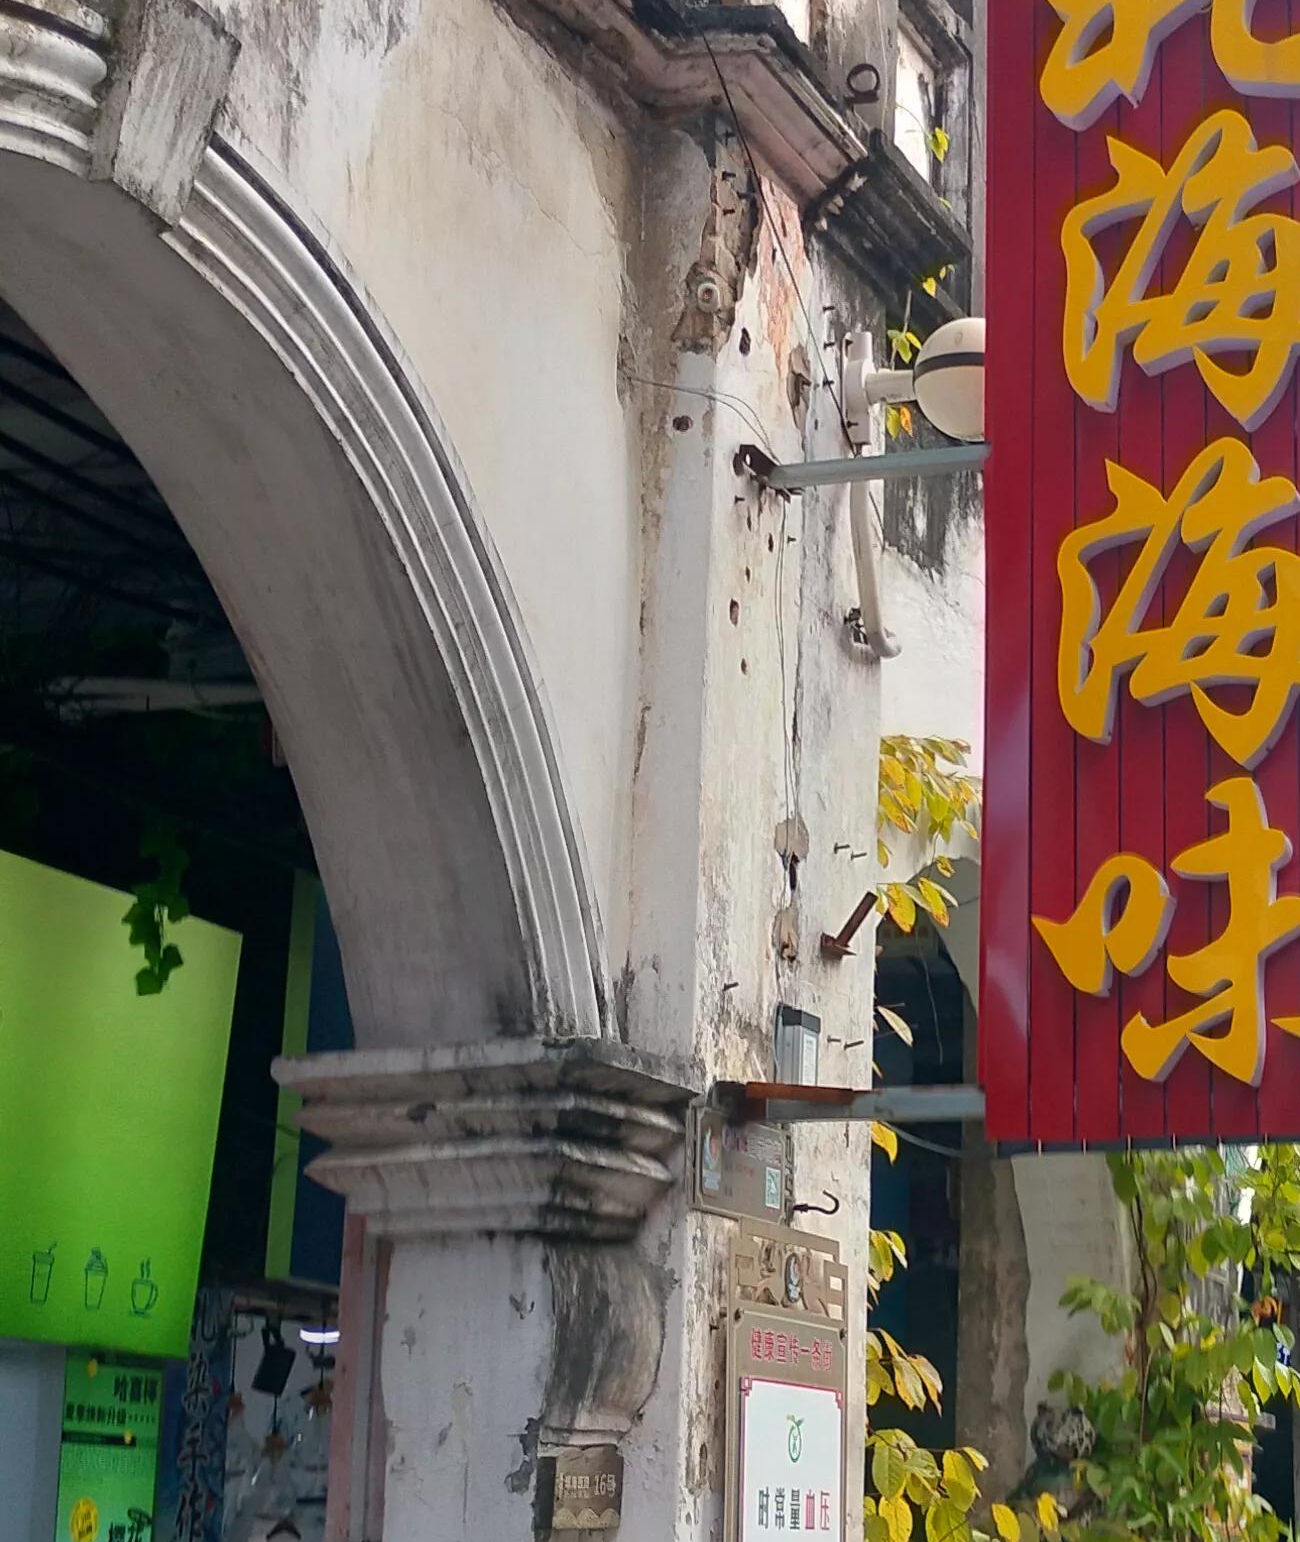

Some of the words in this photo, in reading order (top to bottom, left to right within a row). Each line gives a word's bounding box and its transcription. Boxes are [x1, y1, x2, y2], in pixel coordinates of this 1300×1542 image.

[758, 1487, 831, 1530] 时常量血压
